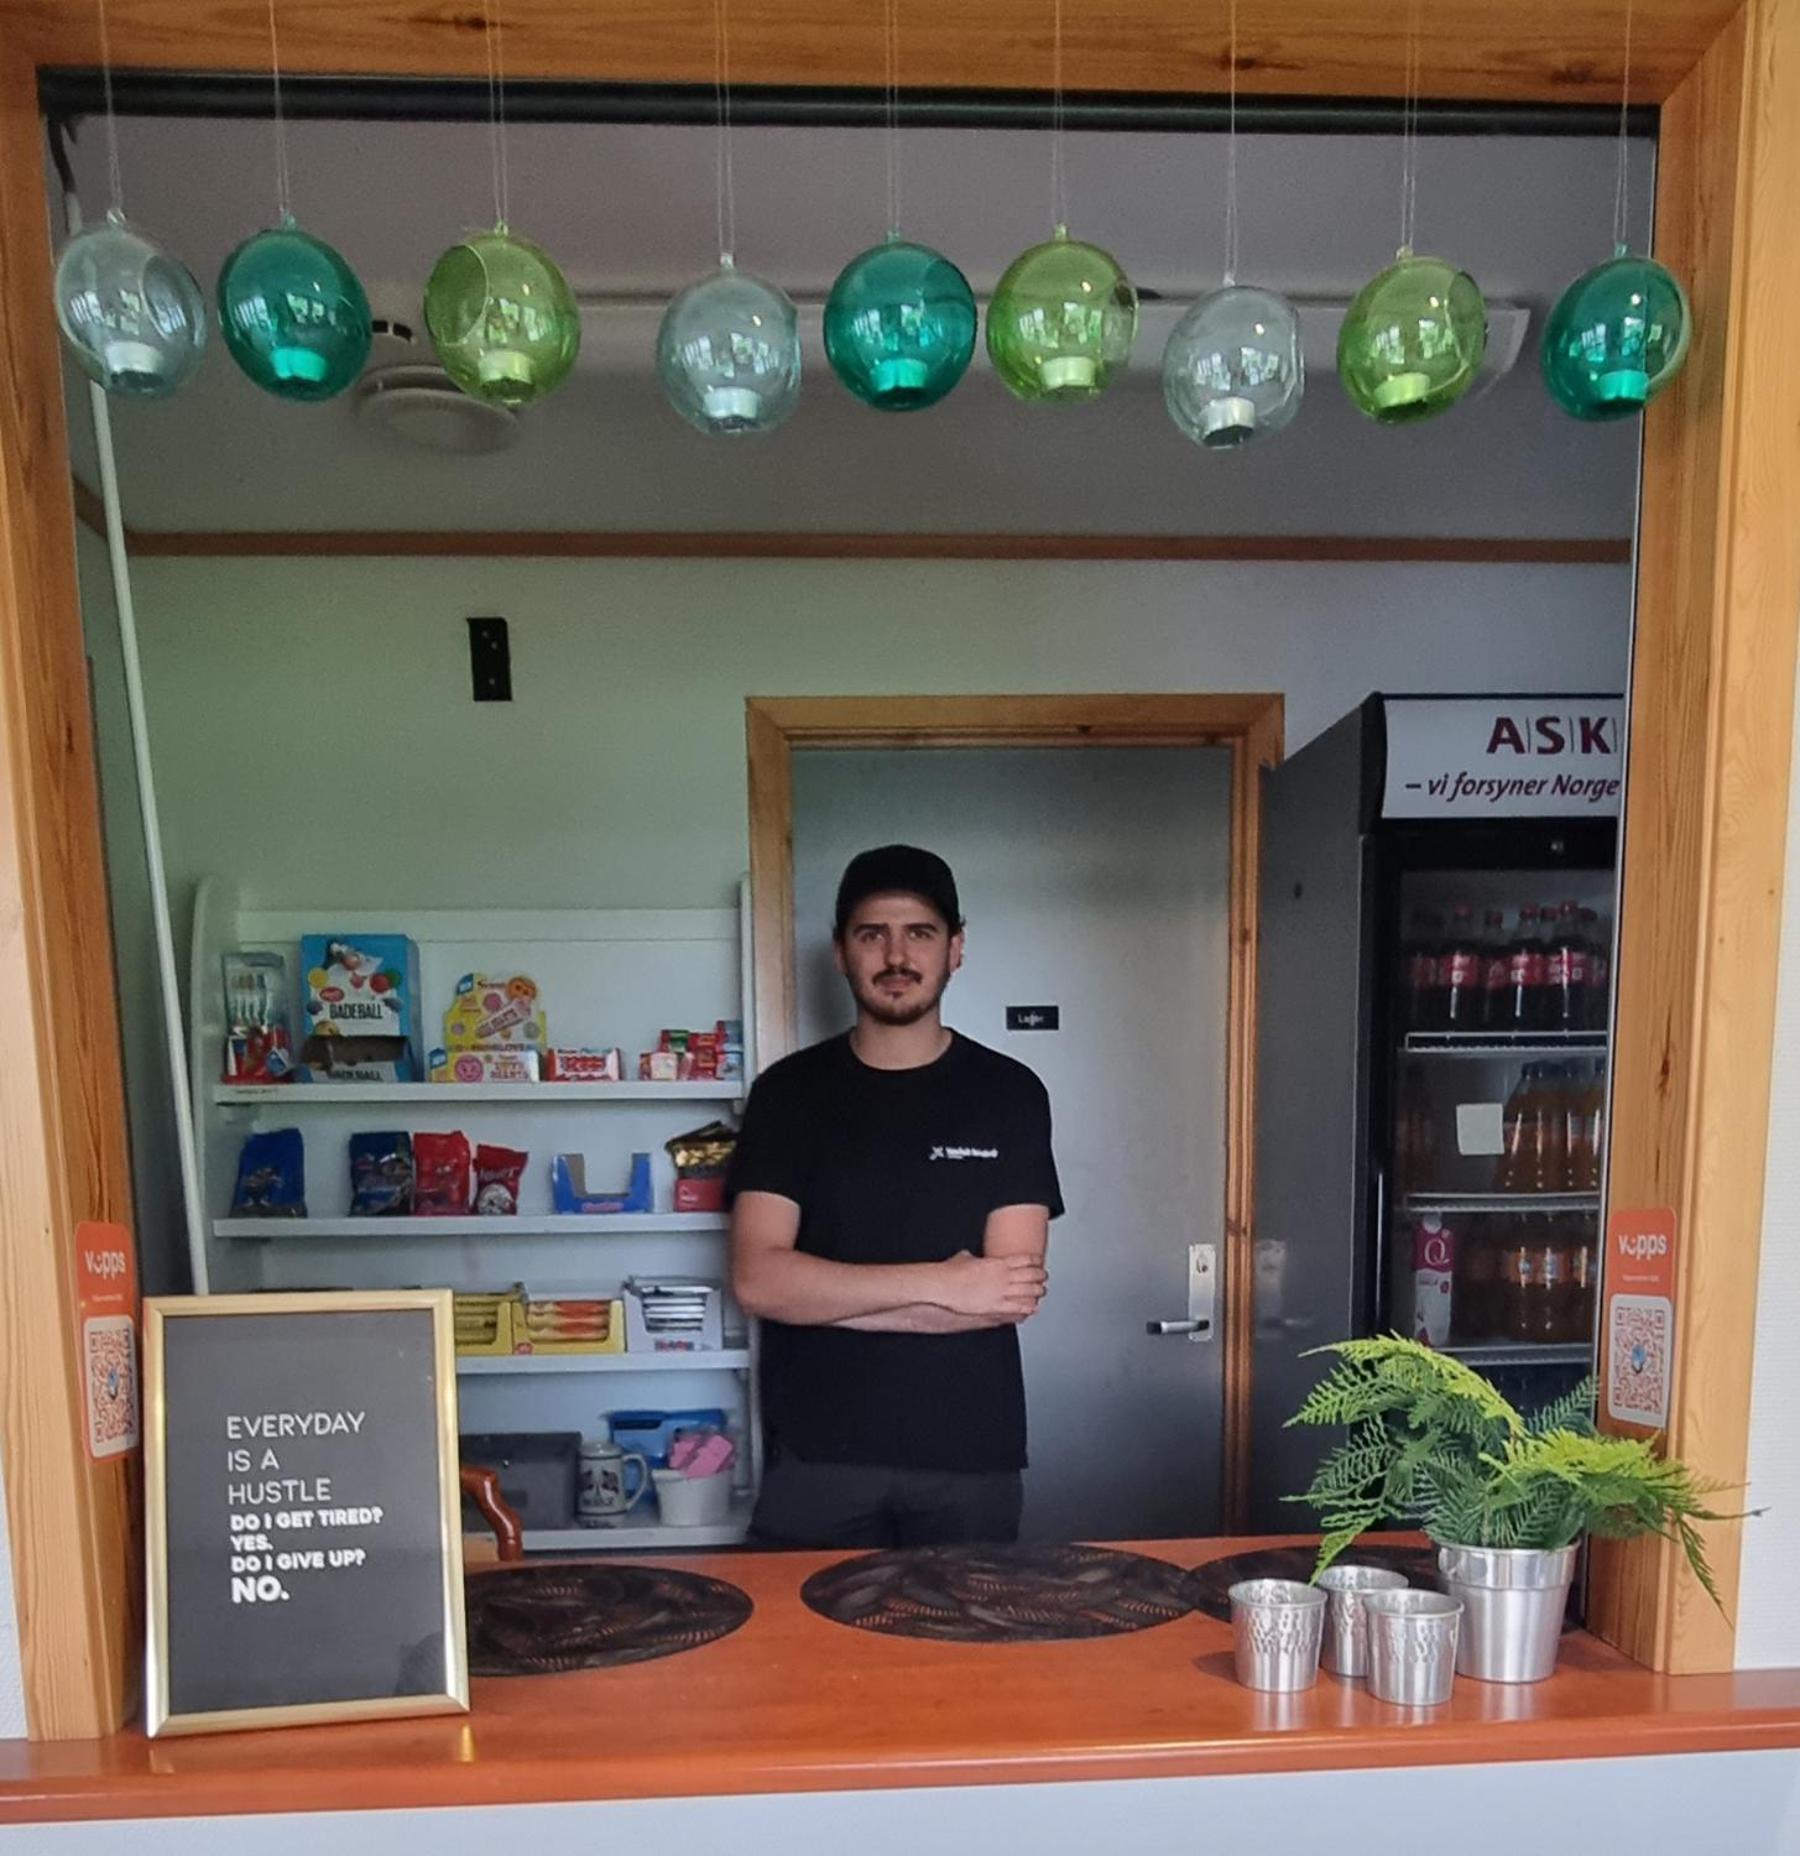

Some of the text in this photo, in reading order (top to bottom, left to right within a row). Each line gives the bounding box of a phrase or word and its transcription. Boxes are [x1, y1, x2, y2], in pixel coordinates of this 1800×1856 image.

[1427, 772, 1450, 796] vi
[1446, 770, 1548, 802] forsyner
[1551, 773, 1620, 803] Norge
[329, 1003, 383, 1019] BADEBALL
[226, 1411, 366, 1440] EVERYDAY
[228, 1448, 280, 1472] IS A
[228, 1477, 332, 1505] HUSTLE
[230, 1506, 384, 1531] DO I GET TIRED?
[230, 1533, 274, 1552] YES.
[231, 1548, 366, 1573] DO I GIVE UP?
[231, 1575, 290, 1604] NO.
